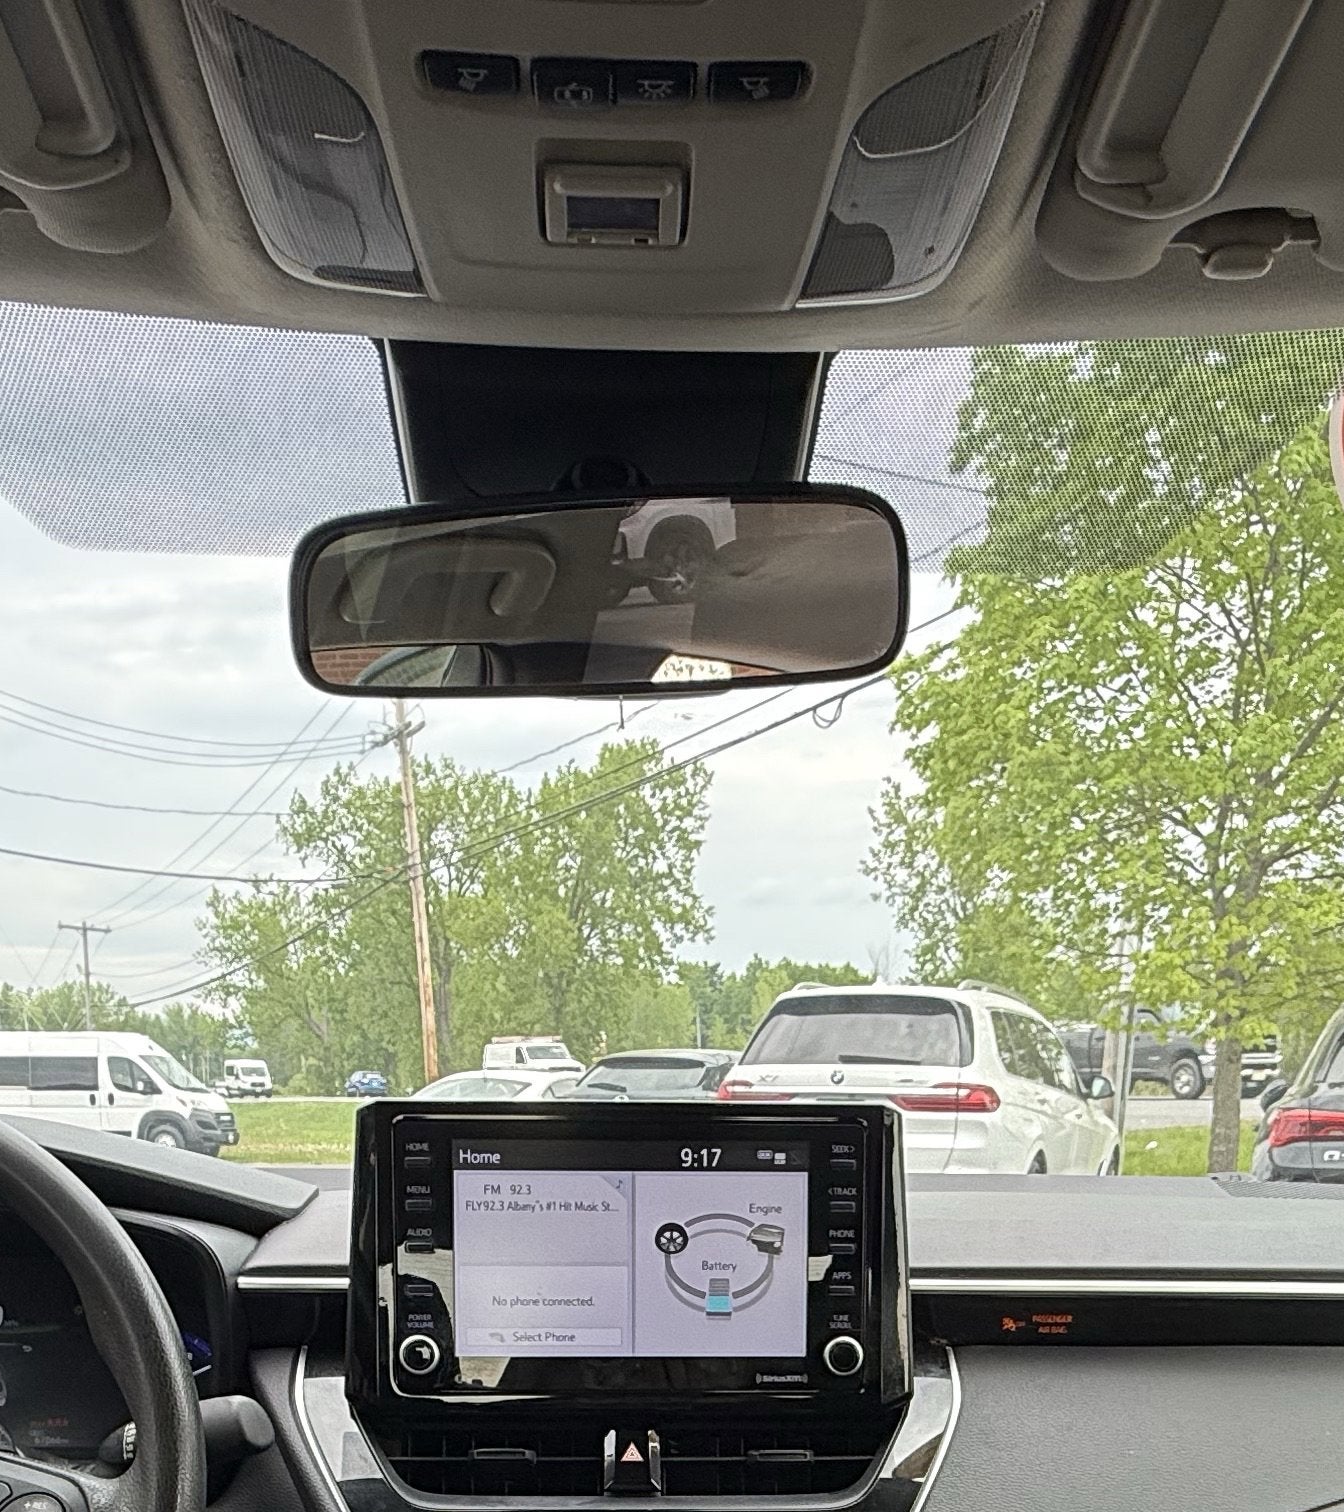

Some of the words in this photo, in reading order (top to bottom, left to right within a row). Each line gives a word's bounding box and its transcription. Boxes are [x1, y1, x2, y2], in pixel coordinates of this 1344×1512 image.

[405, 1143, 430, 1151] HOME
[459, 1149, 501, 1164] Home
[680, 1148, 722, 1167] 9:17
[406, 1185, 431, 1194] MENU
[483, 1184, 501, 1194] FM
[509, 1184, 532, 1194] 92.3
[465, 1202, 505, 1211] FLY92.3
[558, 1202, 573, 1211] Hit
[574, 1202, 599, 1211] Music
[748, 1203, 782, 1215] Engine
[406, 1228, 432, 1236] AUDIO
[829, 1229, 856, 1238] PHONE
[701, 1259, 737, 1273] Battery
[832, 1271, 852, 1280] APPS
[492, 1296, 505, 1306] No
[507, 1296, 541, 1309] phone
[542, 1296, 595, 1306] connected.
[1032, 1314, 1073, 1323] PASSENGER
[512, 1331, 543, 1343] Select
[545, 1331, 576, 1343] Phone
